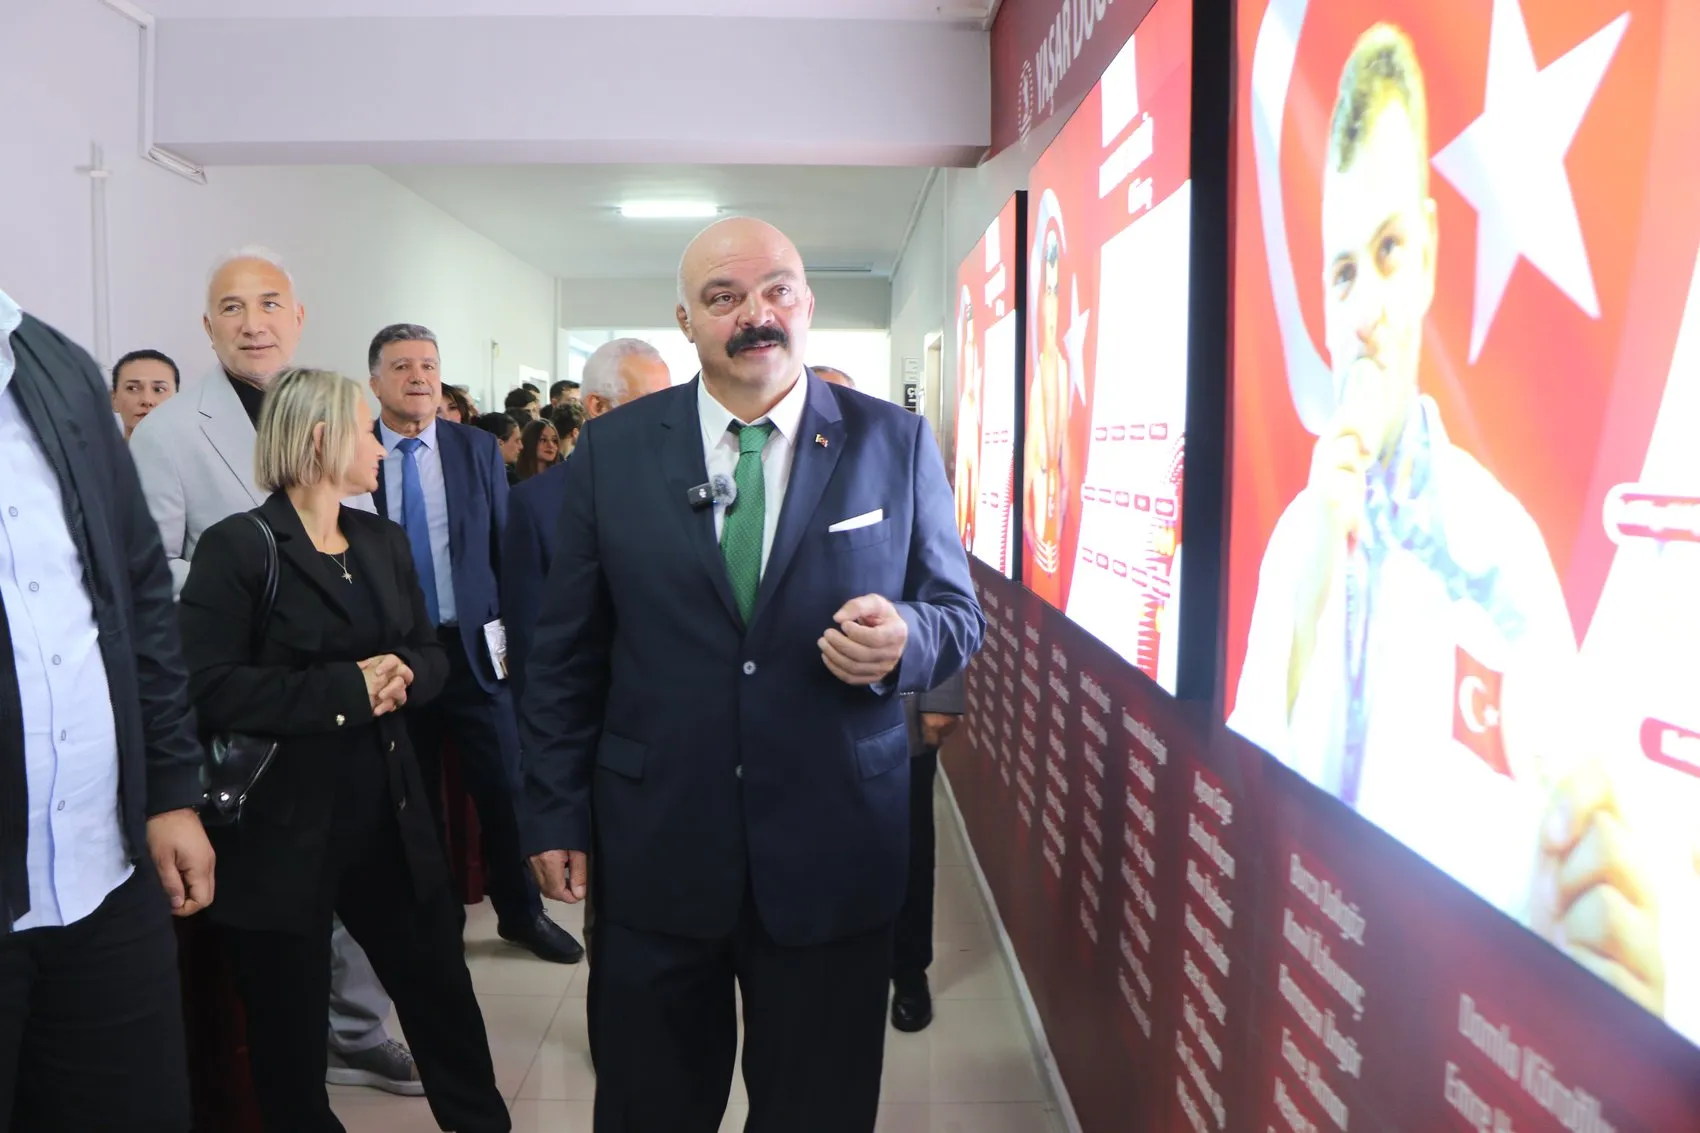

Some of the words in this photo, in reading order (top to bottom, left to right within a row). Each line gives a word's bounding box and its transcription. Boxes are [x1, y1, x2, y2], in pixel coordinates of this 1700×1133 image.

[1035, 0, 1071, 116] YAŞAR
[1458, 993, 1521, 1081] Damla
[1444, 1060, 1492, 1133] Emre
